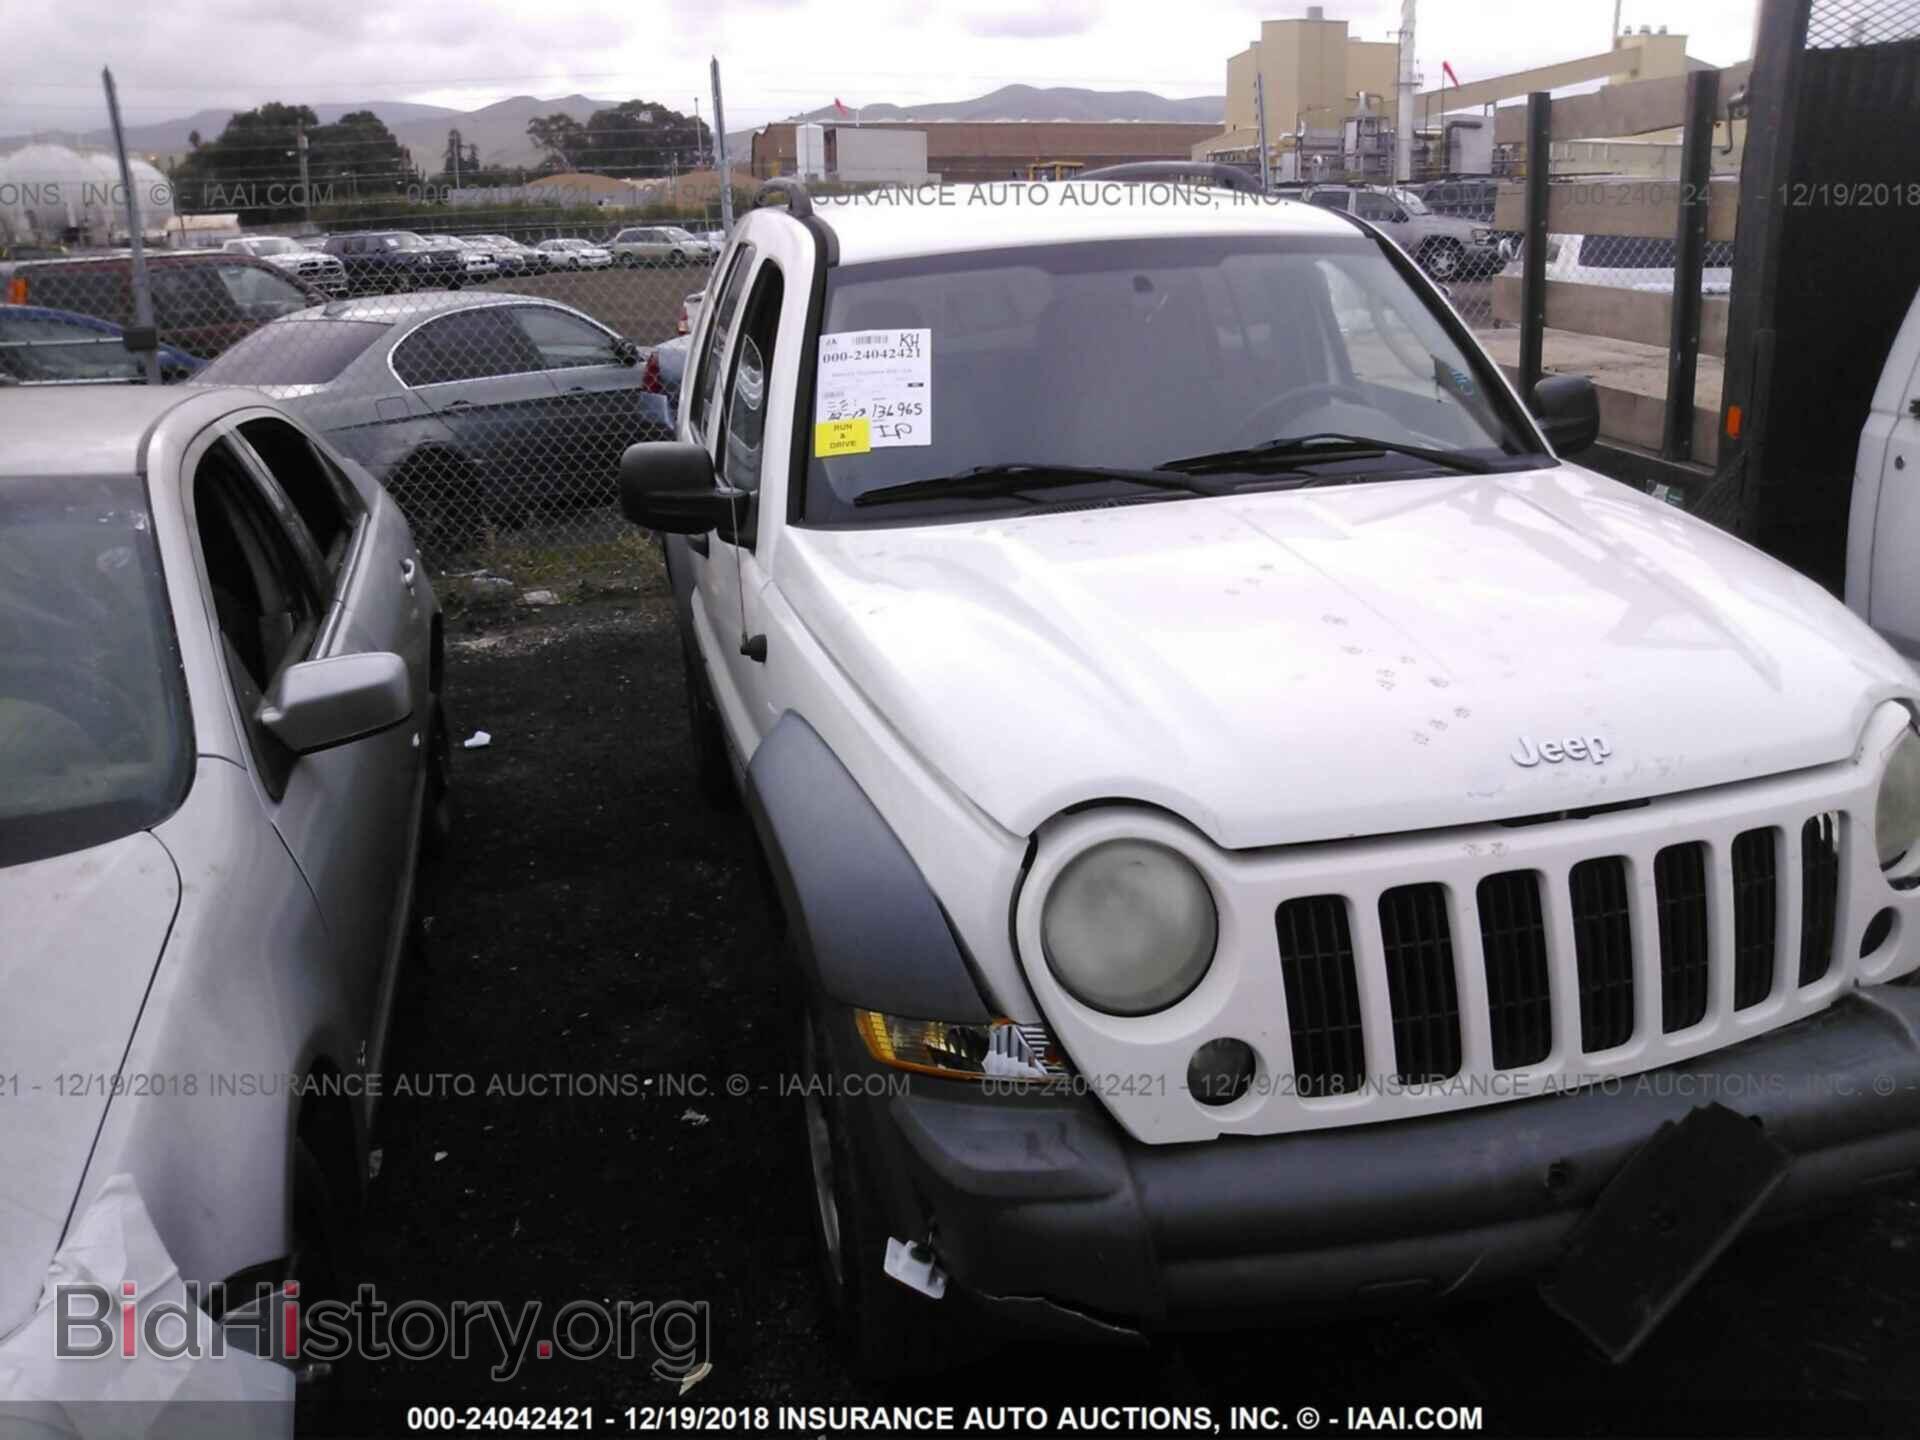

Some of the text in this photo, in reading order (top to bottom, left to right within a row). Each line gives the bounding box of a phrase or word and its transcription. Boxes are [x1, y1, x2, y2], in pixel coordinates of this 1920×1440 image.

[823, 348, 920, 363] 000-24042421
[834, 424, 853, 432] RUN
[829, 441, 856, 449] DRIVE
[1511, 735, 1612, 768] Jeep
